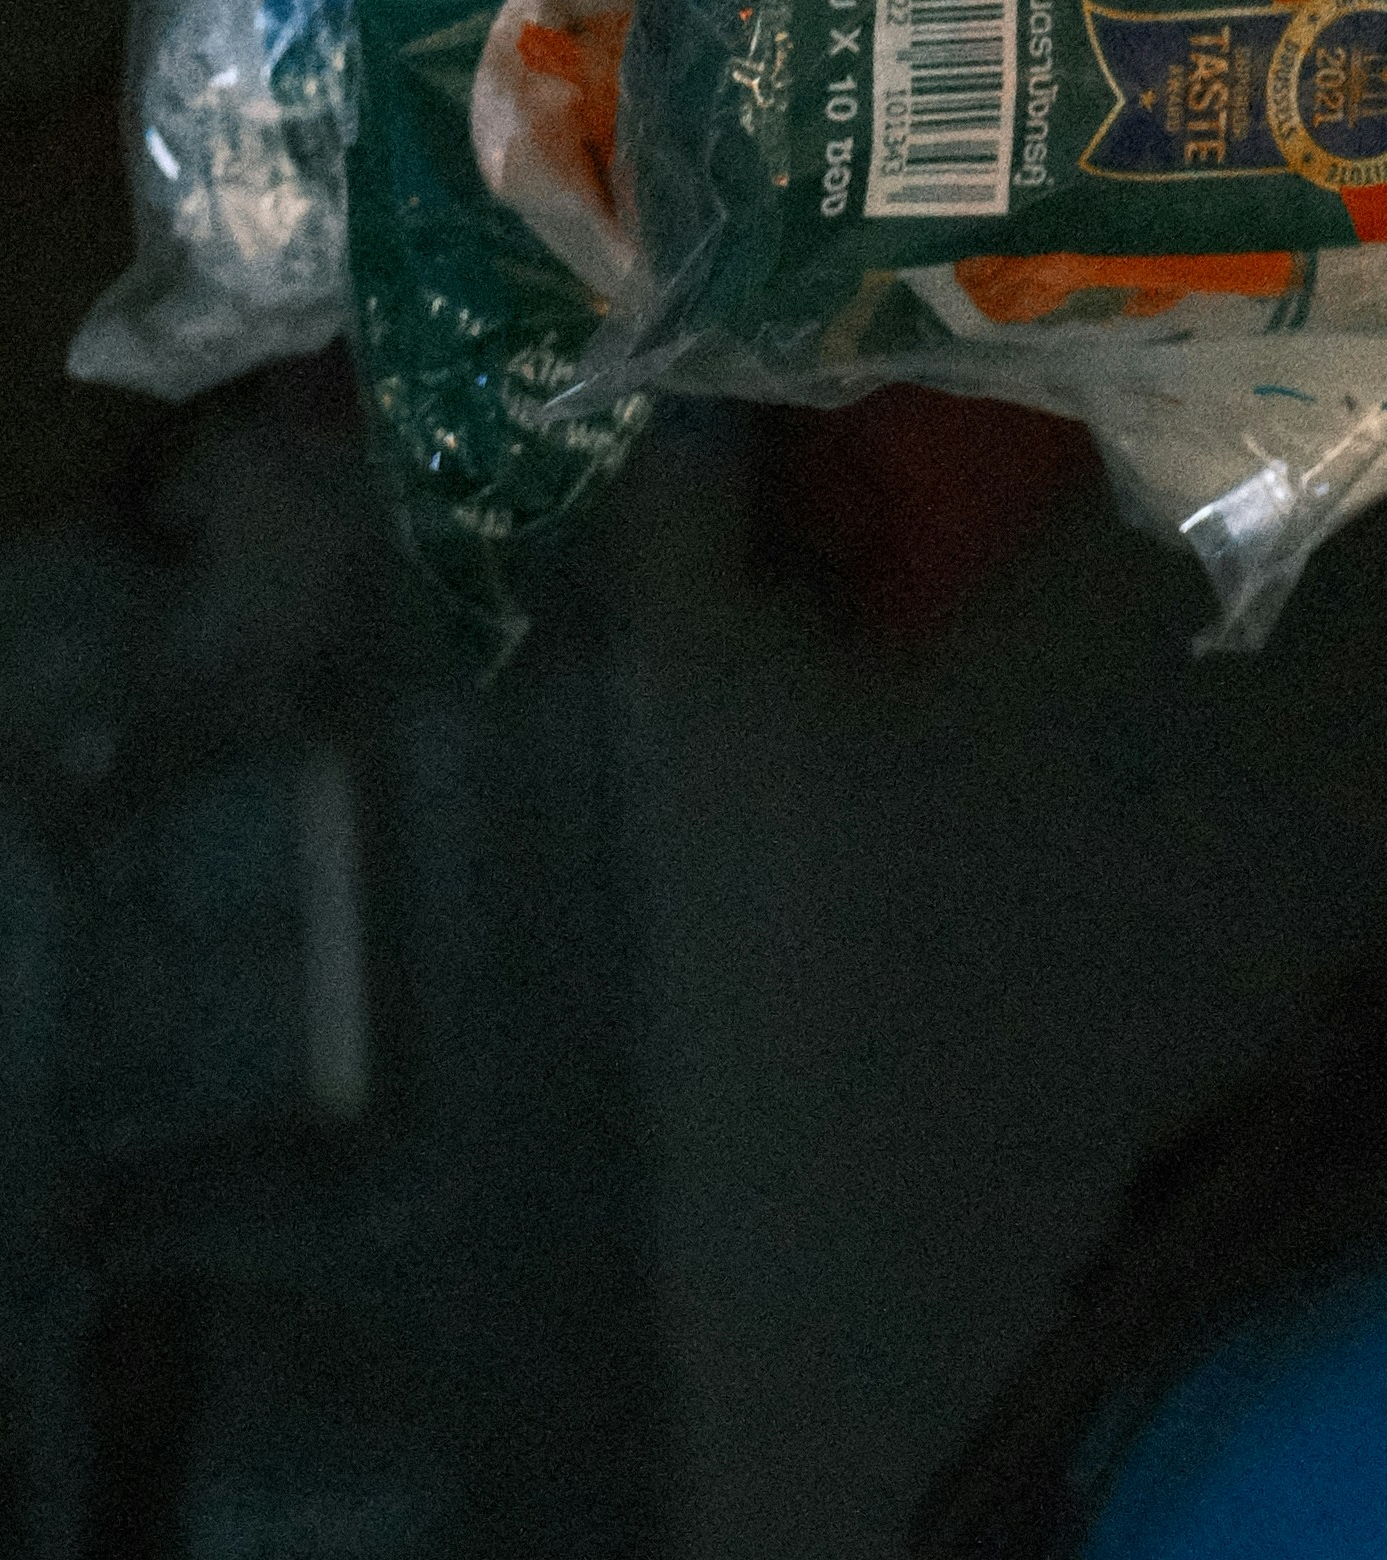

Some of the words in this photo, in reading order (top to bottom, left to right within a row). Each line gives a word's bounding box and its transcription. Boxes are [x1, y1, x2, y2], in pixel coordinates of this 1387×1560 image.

[826, 75, 859, 121] 10
[1184, 25, 1231, 164] TASTE
[1313, 47, 1346, 128] 2021
